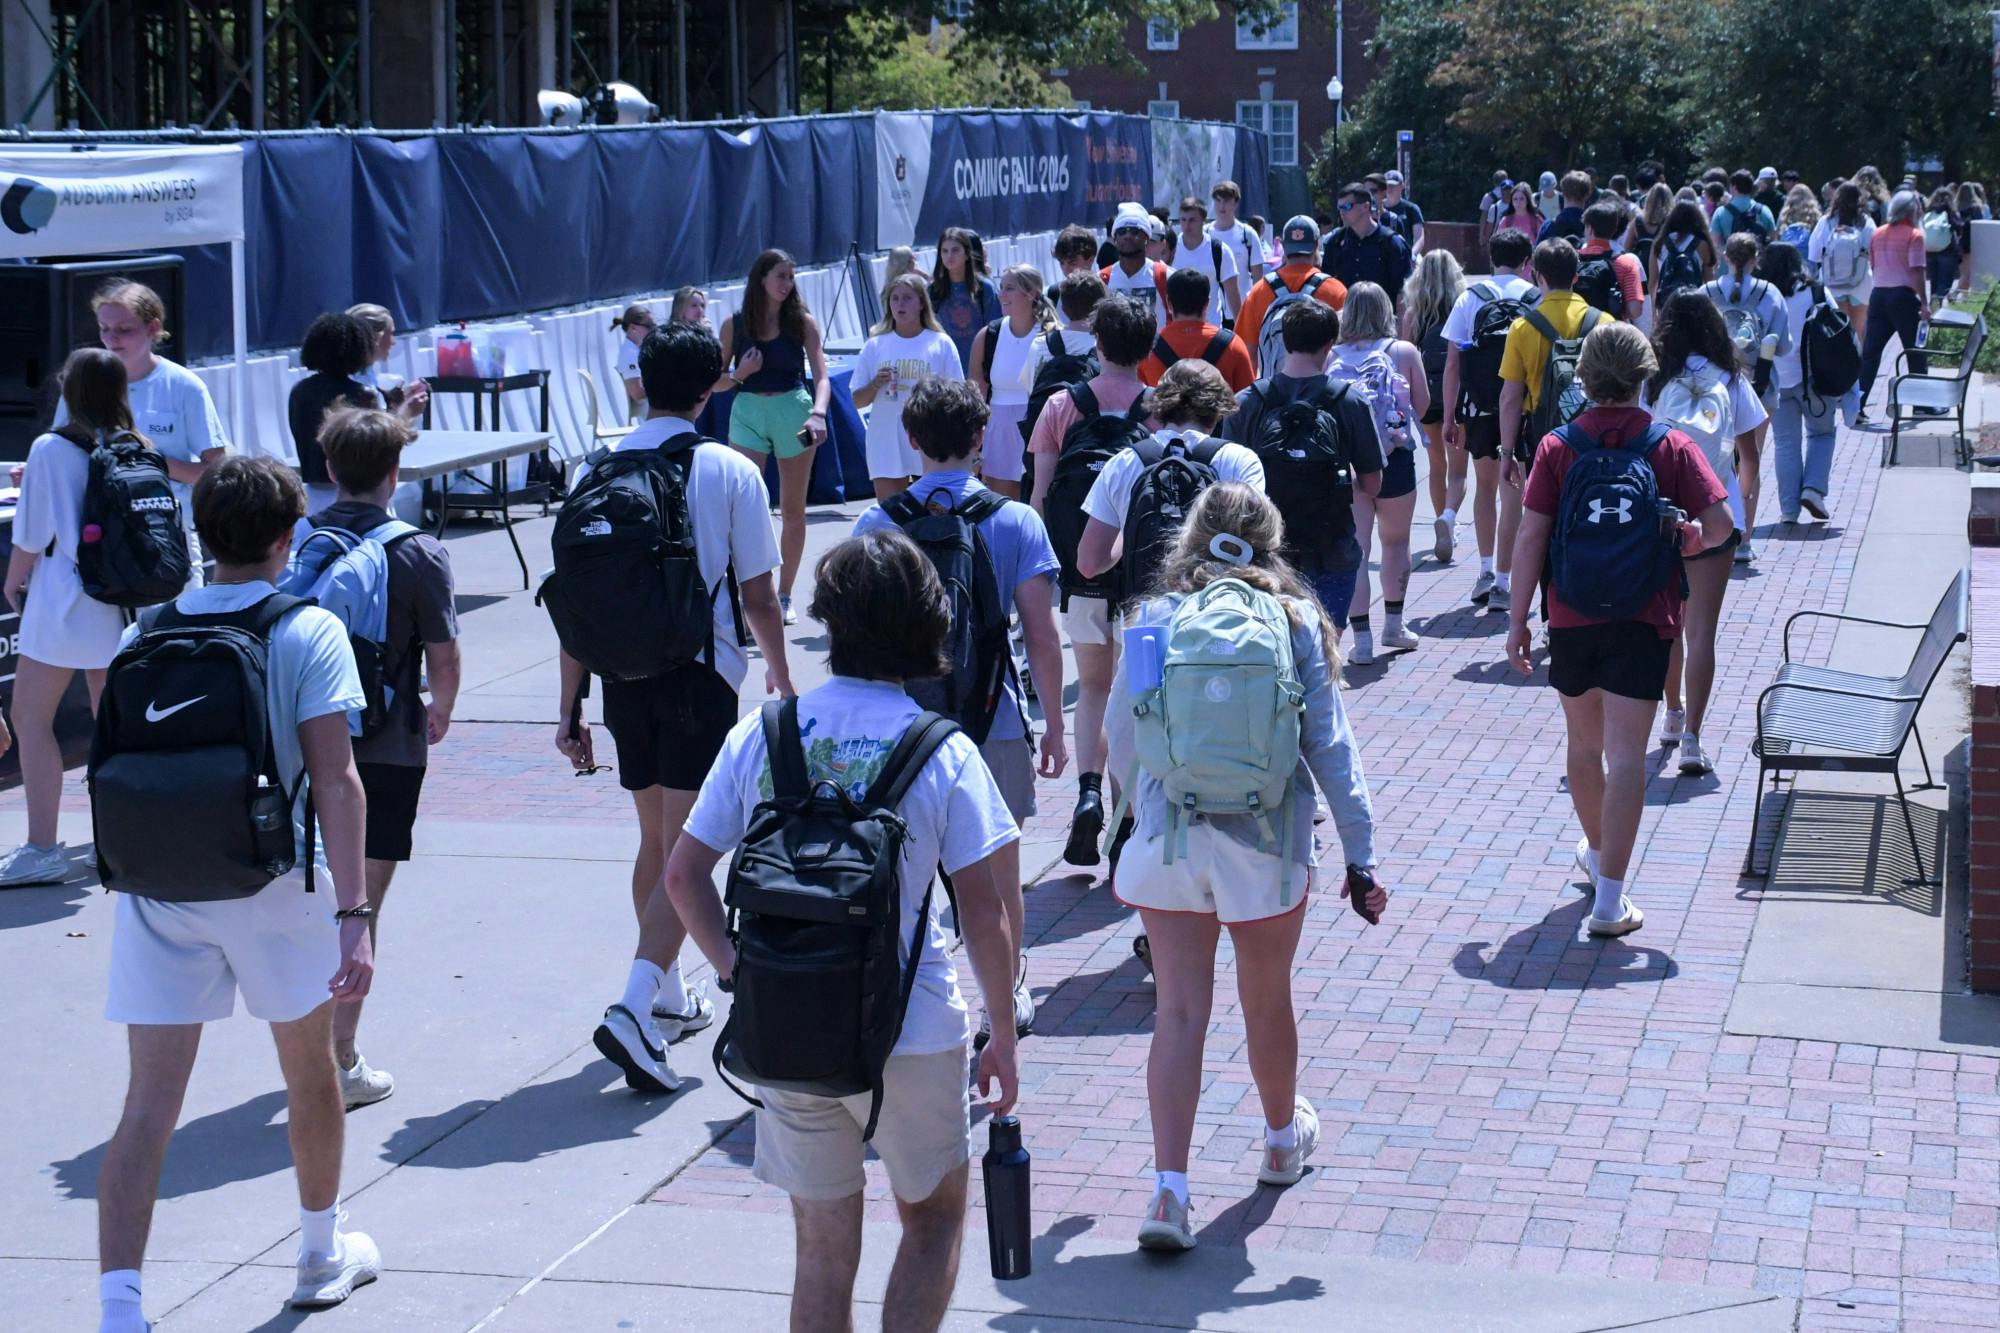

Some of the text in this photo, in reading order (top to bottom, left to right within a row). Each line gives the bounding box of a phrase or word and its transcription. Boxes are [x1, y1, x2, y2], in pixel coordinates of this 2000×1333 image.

[954, 157, 1010, 200] COMING
[1011, 155, 1038, 194] FALL
[60, 178, 196, 206] AUBURN ANSWERS
[149, 424, 167, 432] SGA
